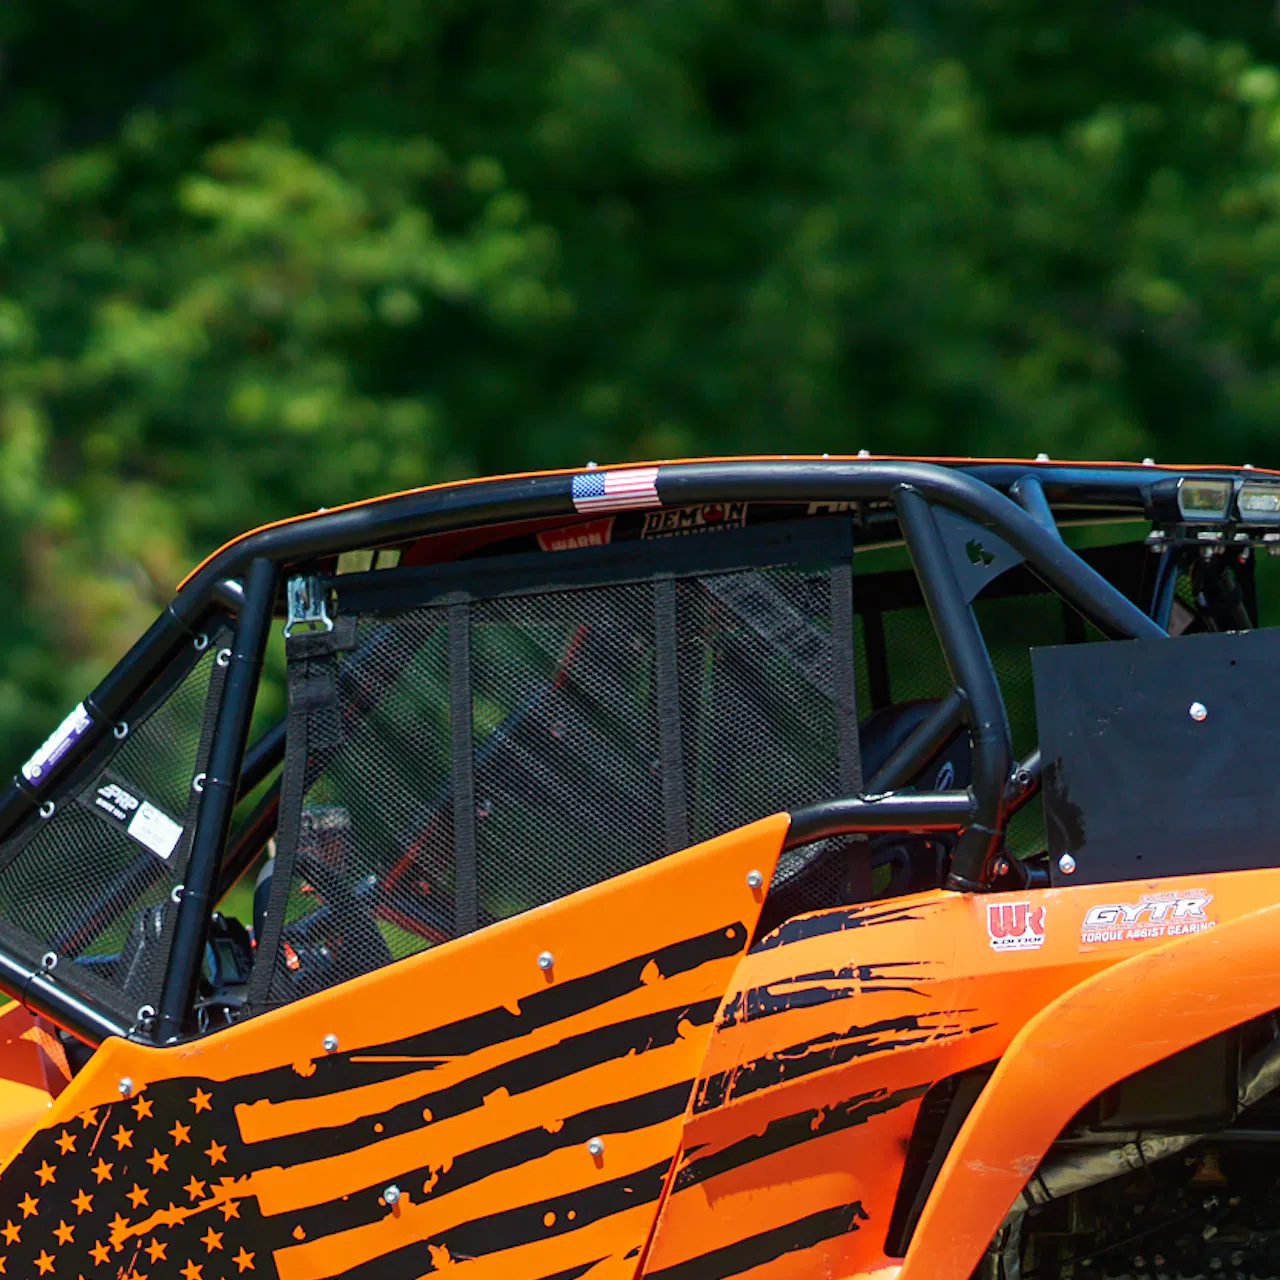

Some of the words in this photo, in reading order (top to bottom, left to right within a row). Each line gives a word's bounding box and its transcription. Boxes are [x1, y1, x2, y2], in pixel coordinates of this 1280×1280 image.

[646, 503, 745, 531] DEMON
[551, 531, 603, 551] WARN
[1084, 894, 1213, 925] GYTR
[1081, 930, 1124, 943] TORQUE
[1126, 926, 1166, 940] ASSIST
